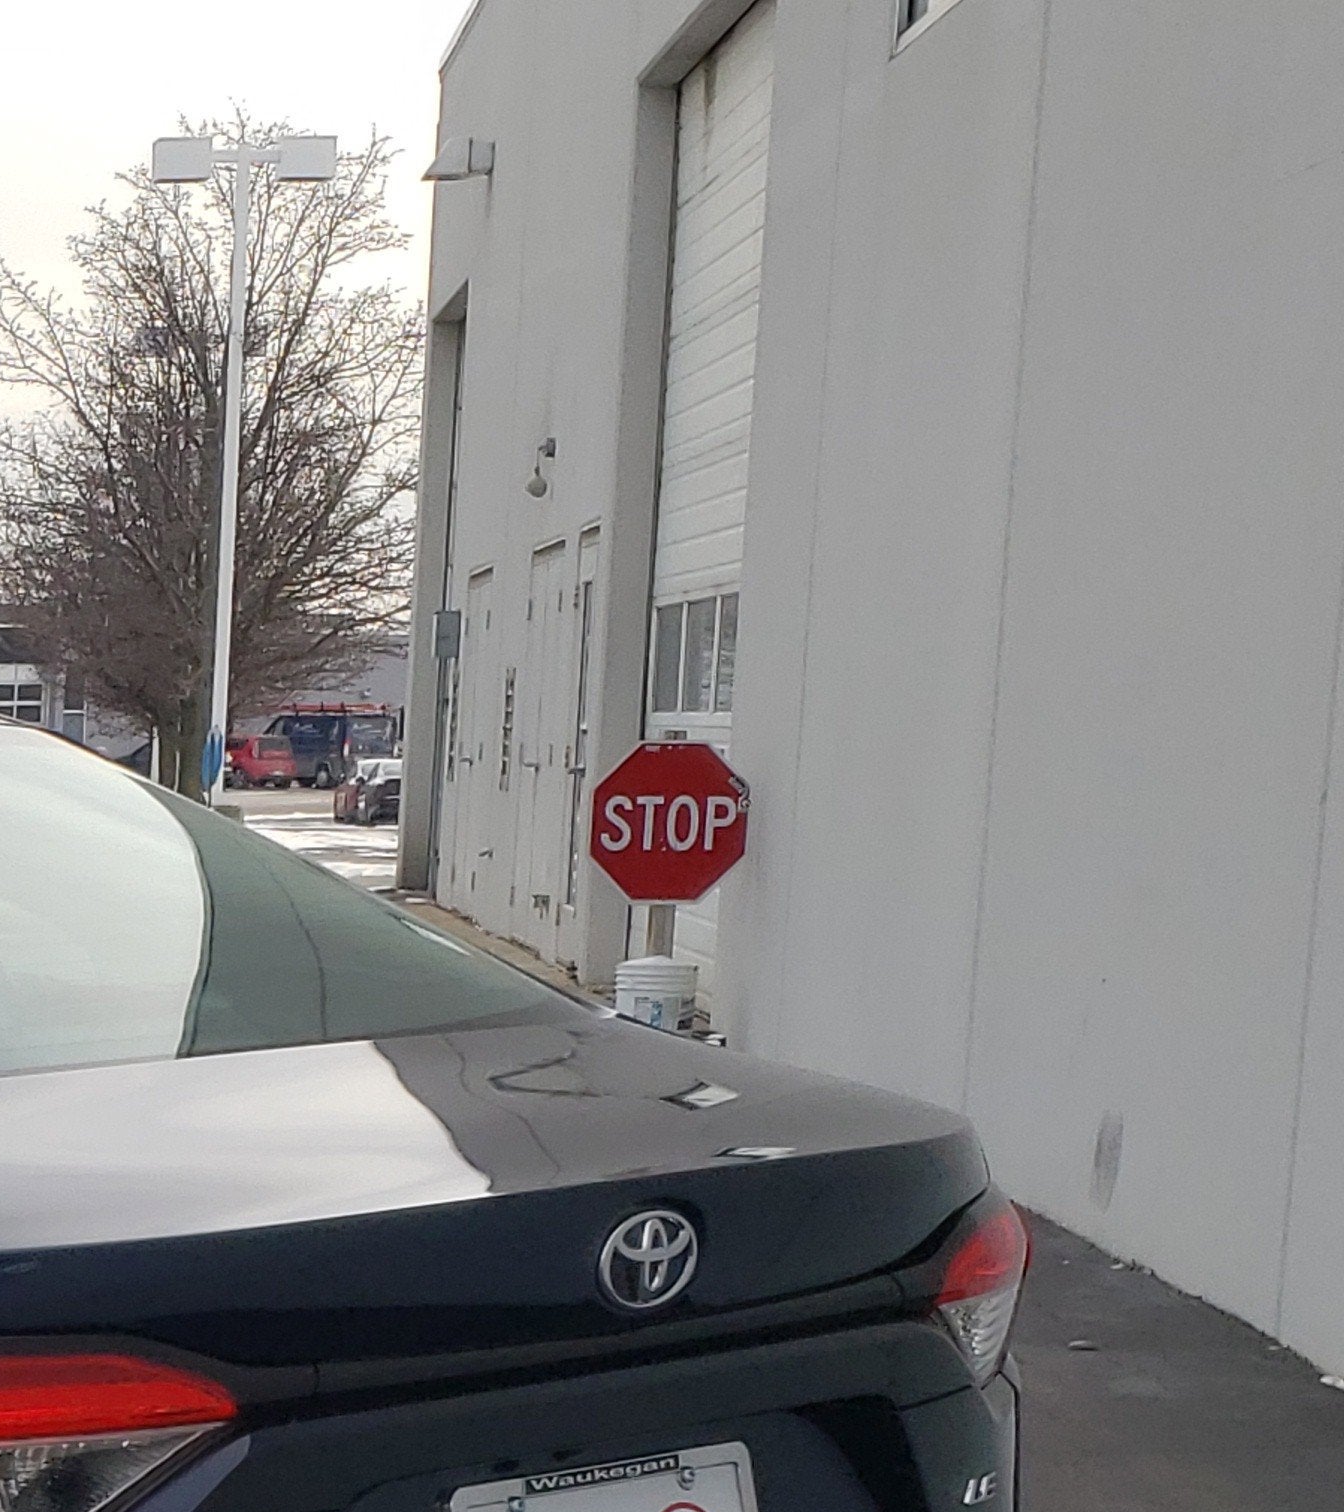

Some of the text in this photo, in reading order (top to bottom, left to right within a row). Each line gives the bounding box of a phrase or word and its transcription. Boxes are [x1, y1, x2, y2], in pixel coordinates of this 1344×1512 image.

[600, 794, 738, 853] STOP
[530, 1456, 677, 1491] Waukegan
[963, 1471, 997, 1506] LE
